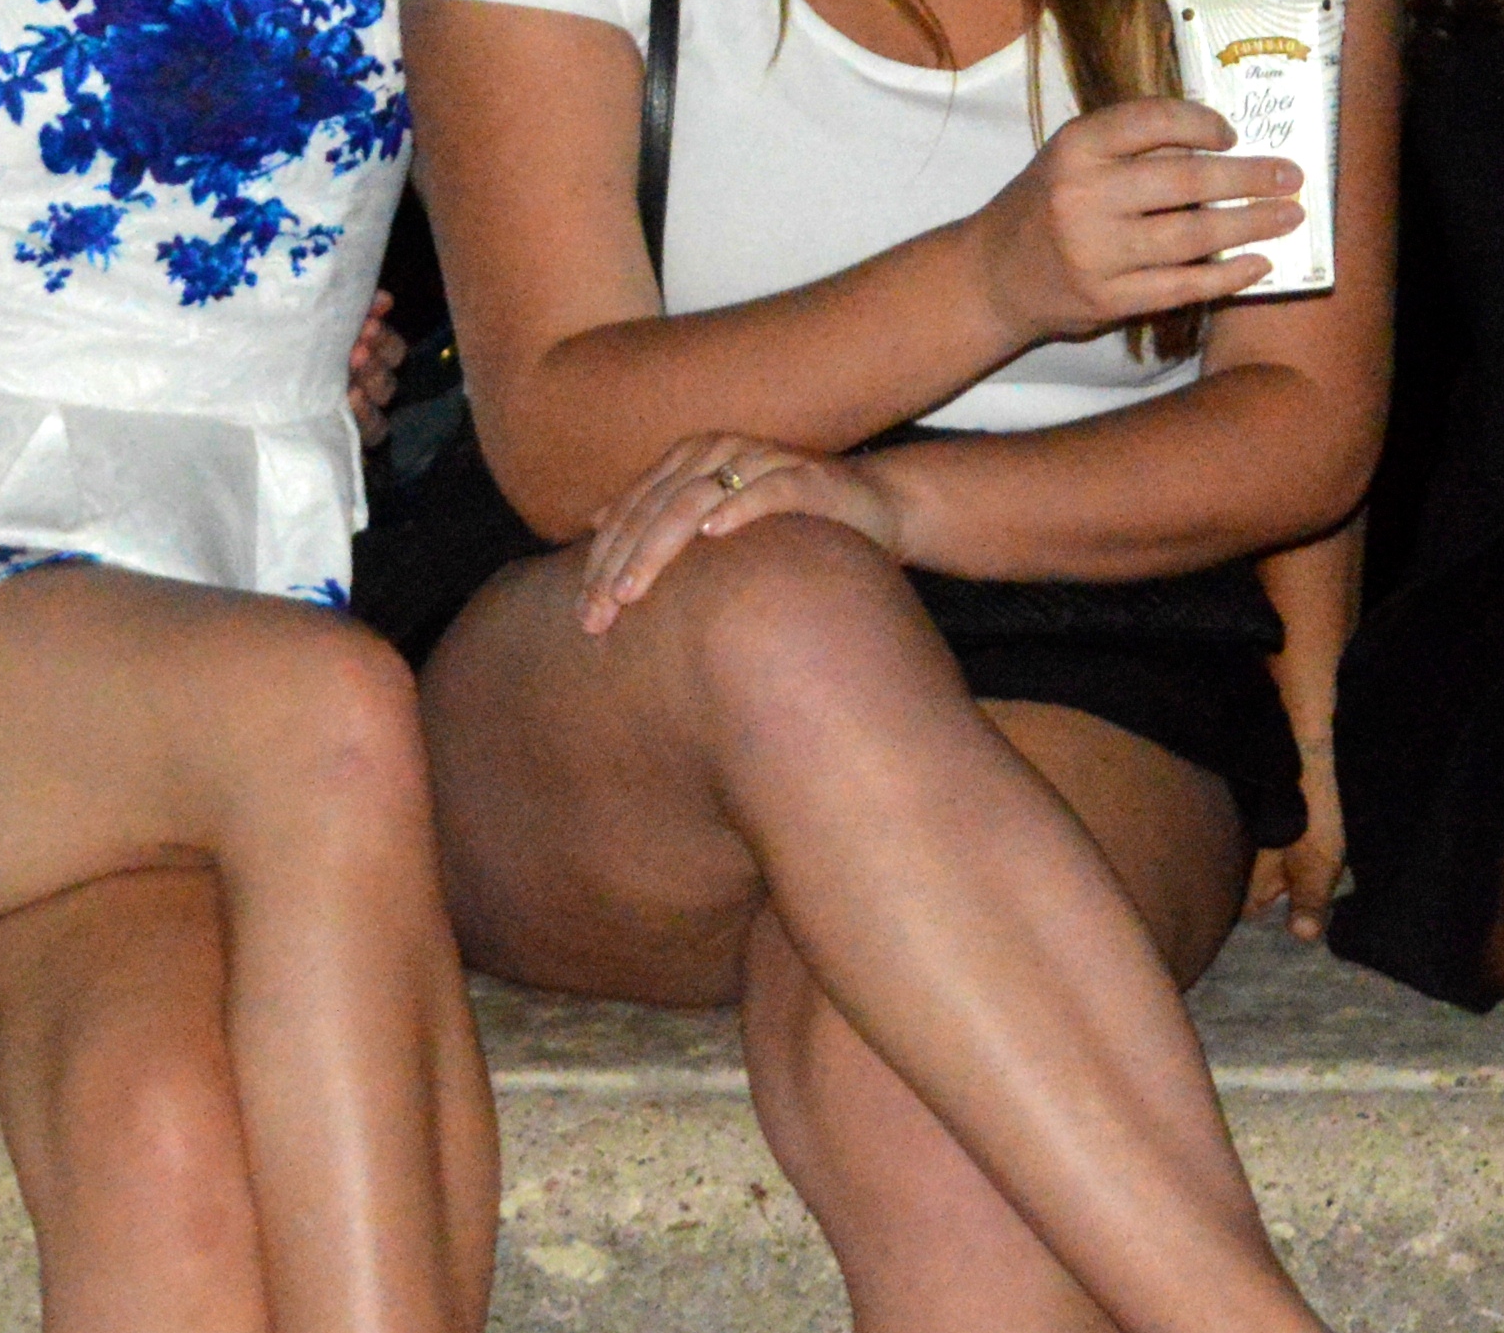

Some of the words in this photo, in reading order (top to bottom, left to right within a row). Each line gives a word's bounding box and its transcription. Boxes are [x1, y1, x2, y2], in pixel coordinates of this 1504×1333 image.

[1244, 64, 1283, 80] Rum
[1230, 86, 1295, 124] Silver
[1244, 114, 1295, 149] Dry
